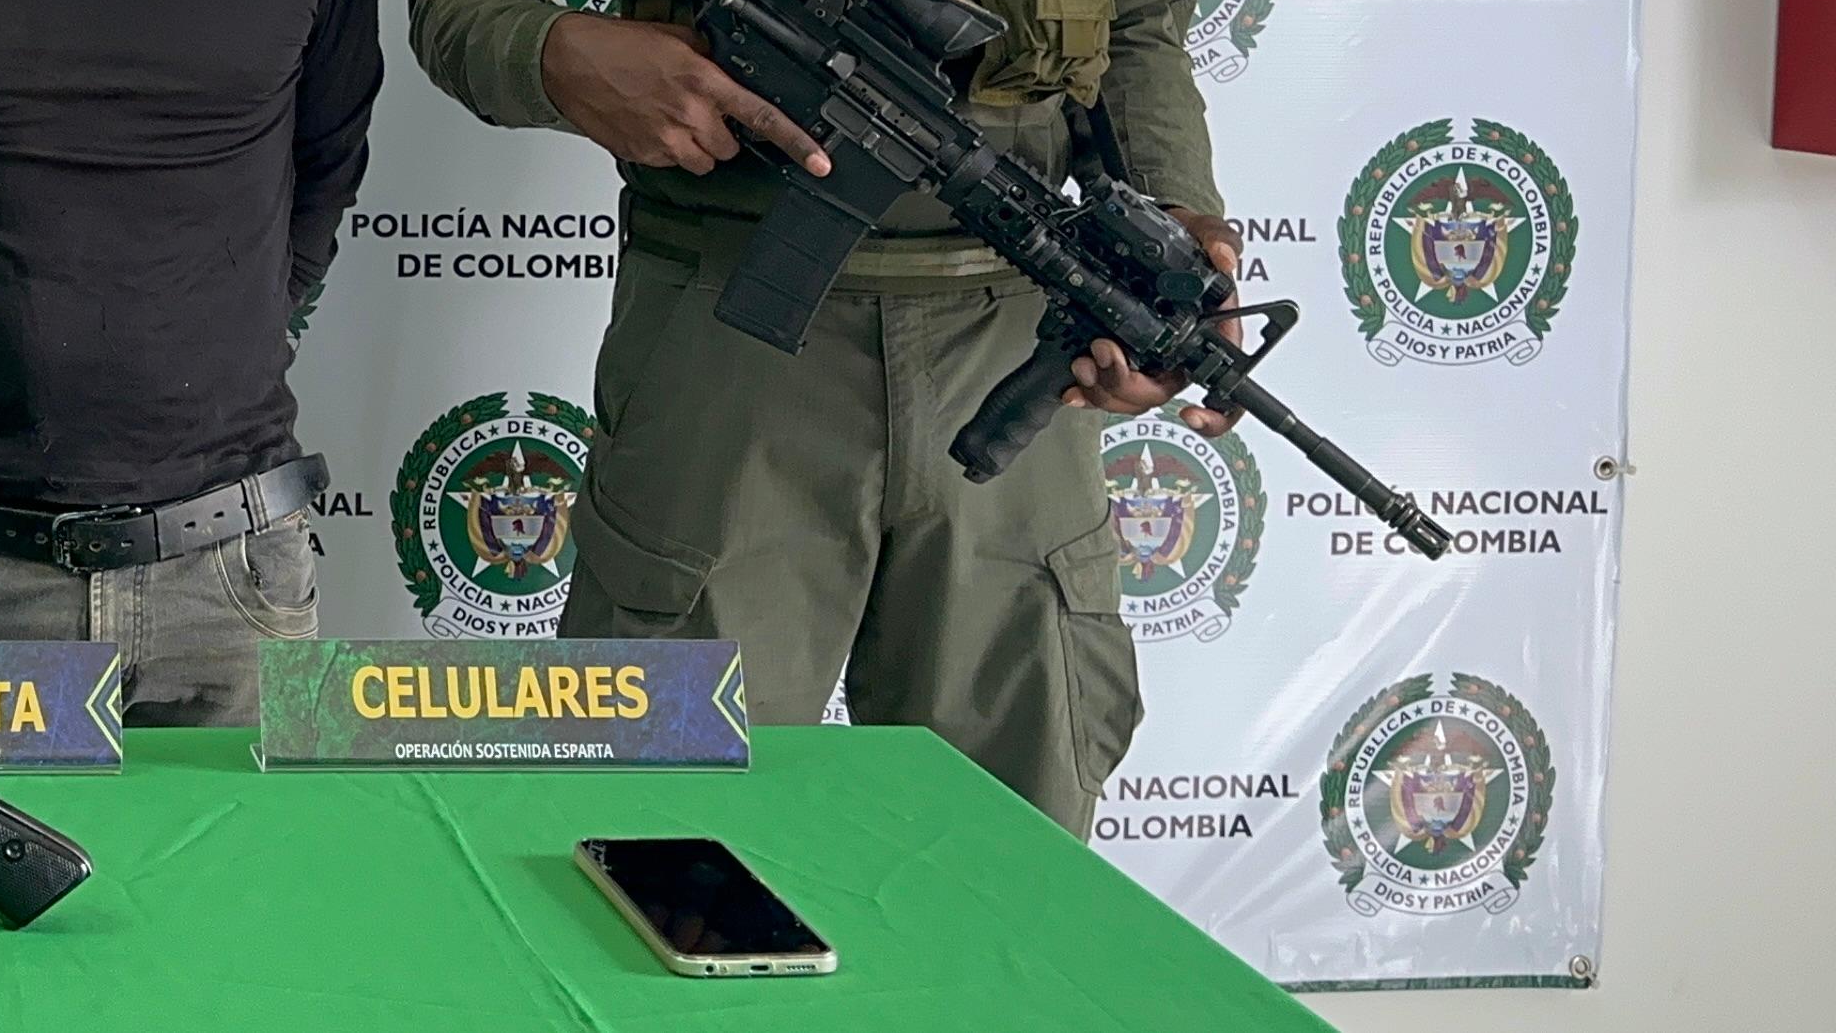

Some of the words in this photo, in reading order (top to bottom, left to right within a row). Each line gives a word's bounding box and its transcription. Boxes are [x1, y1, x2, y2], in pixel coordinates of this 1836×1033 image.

[1369, 157, 1431, 255] REPÚBLICA
[1452, 147, 1476, 160] DE
[1497, 159, 1547, 255] COLOMBIA
[351, 205, 488, 237] POLICÍA
[502, 214, 615, 240] NACIO
[398, 254, 441, 277] DE
[453, 254, 617, 280] COLOMBI
[1457, 279, 1538, 335] NACIONAL
[1395, 331, 1436, 357] DIOS
[1439, 345, 1451, 358] Y
[1455, 332, 1516, 358] PATRIA
[423, 431, 486, 530] REPÚBLICA
[508, 421, 533, 434] DE
[1432, 491, 1607, 514] NACIONAL
[1332, 532, 1373, 555] DE
[1384, 529, 1562, 556] COMBIA
[452, 607, 495, 634] DIOS
[499, 622, 511, 635] Y
[352, 665, 648, 719] CELULARES
[394, 739, 473, 760] OPERACIÓN
[475, 742, 552, 760] SOSTENIDA
[553, 742, 614, 760] ESPARTA
[1432, 701, 1455, 714] DE
[1475, 711, 1525, 806] COLOMBIA
[1120, 775, 1298, 800] NACIONAL
[1095, 814, 1252, 840] OLOMBIA
[1435, 829, 1515, 886] NACIONAL
[1434, 882, 1493, 908] PATRIA
